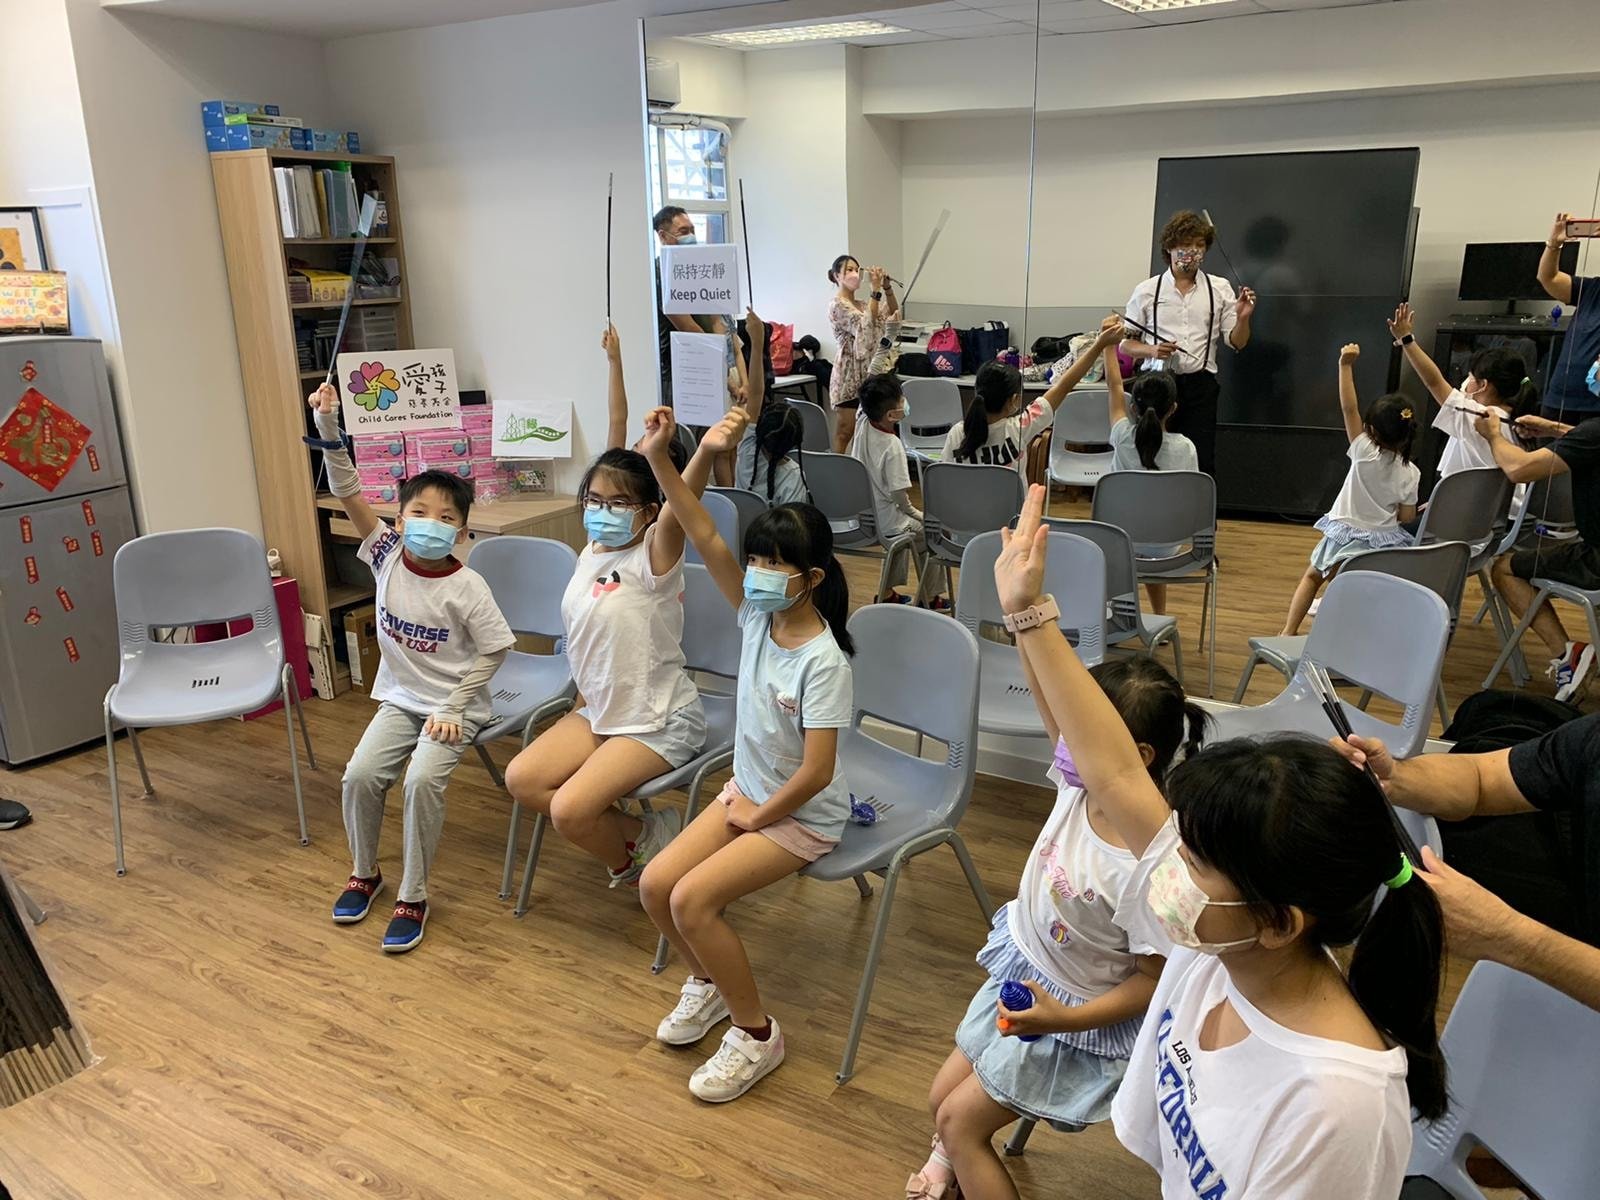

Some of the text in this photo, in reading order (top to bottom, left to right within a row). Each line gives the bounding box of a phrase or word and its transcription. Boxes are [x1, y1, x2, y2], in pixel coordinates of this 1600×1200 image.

[673, 262, 725, 280] 保持安靜
[670, 288, 731, 303] Keep Quiet
[358, 411, 453, 423] Child Cares Foundation
[406, 638, 438, 653] USA
[1171, 1040, 1192, 1065] LOS
